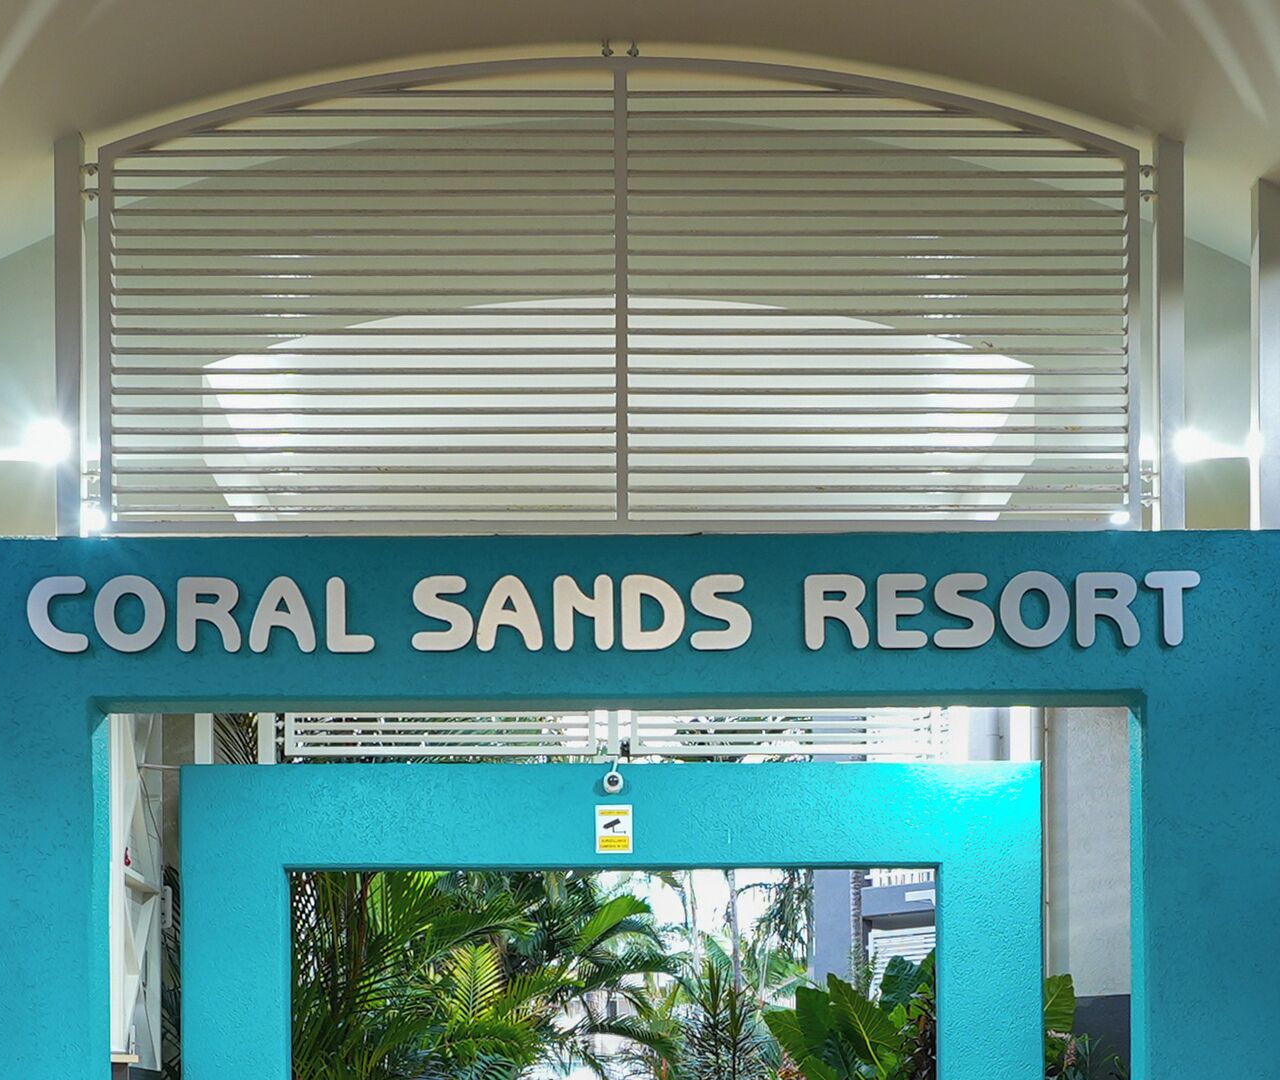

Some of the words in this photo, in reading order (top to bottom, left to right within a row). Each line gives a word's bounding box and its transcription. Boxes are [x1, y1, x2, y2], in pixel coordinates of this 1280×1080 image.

[25, 574, 375, 653] CORAL
[410, 573, 753, 652] SANDS
[803, 570, 1201, 649] RESORT
